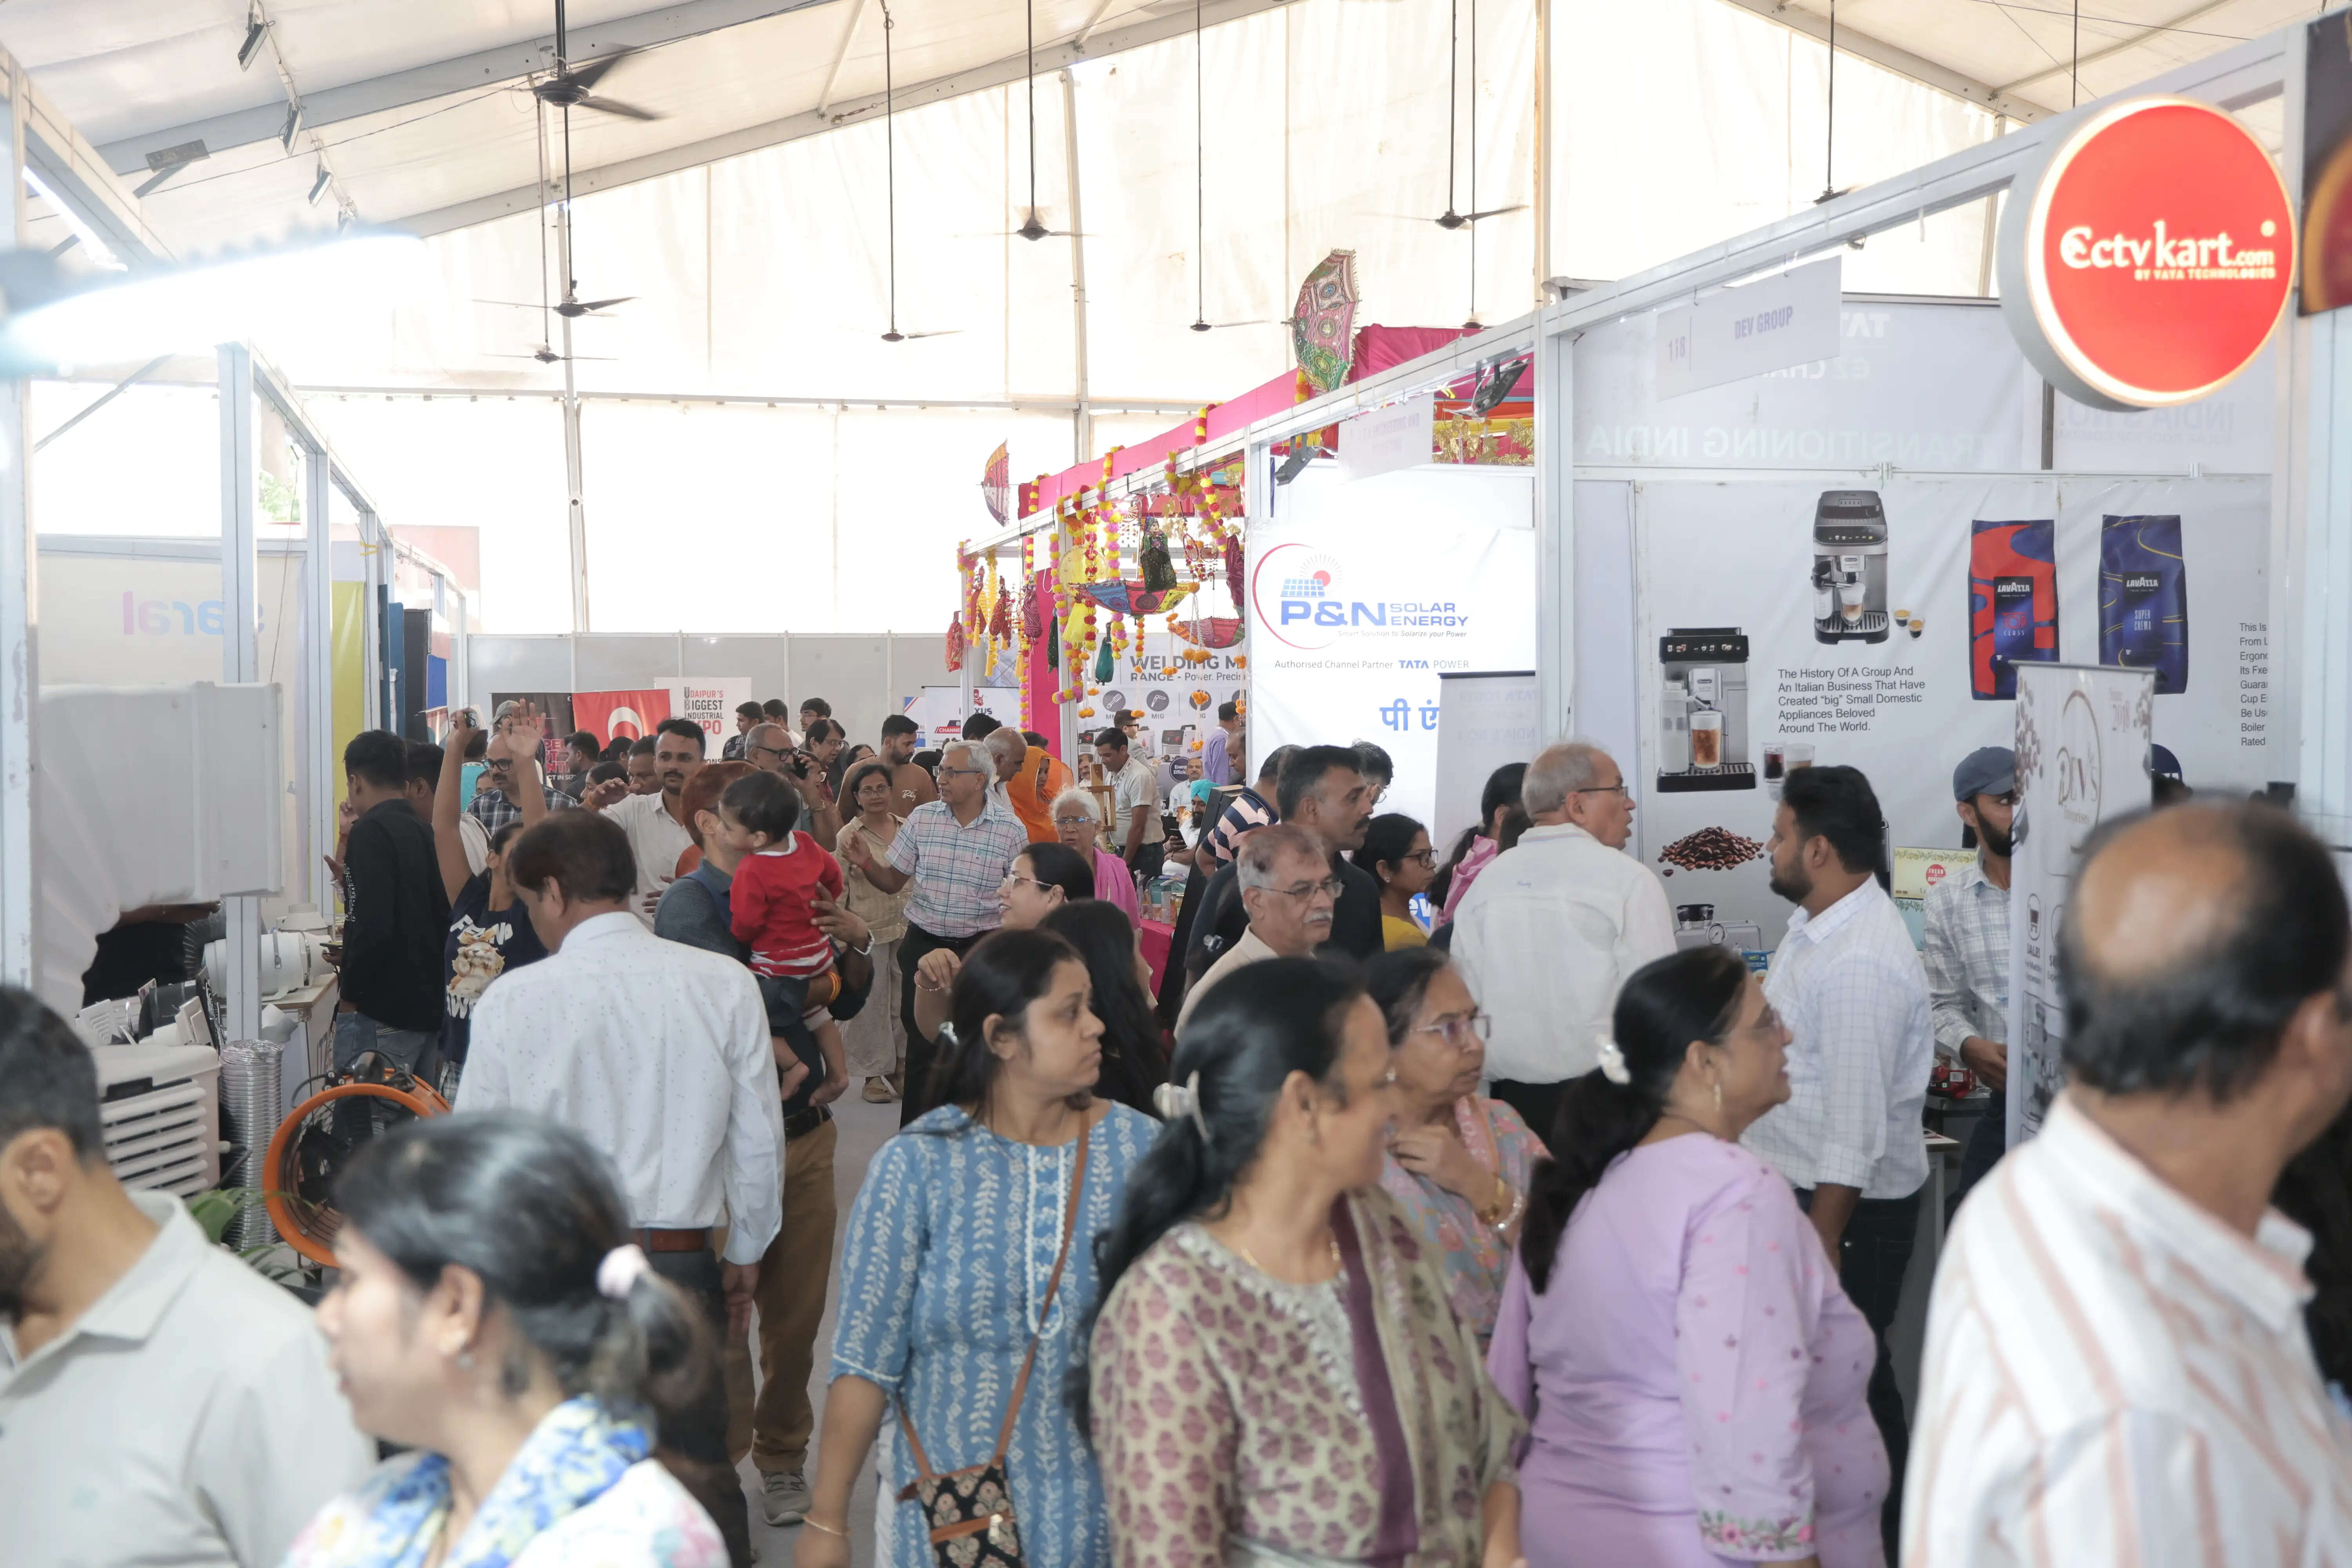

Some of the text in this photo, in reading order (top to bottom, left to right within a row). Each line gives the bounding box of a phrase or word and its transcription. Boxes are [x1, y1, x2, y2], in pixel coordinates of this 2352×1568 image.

[2134, 269, 2151, 281] BY
[2187, 268, 2275, 279] TECHNOLOGIES
[1668, 305, 1794, 361] 118 DEV GROUP
[1997, 582, 2030, 592] LAVAZZA
[2126, 577, 2158, 587] LAVAZZA
[1281, 601, 1455, 626] P&N SOLAR
[2134, 609, 2151, 619] SUPER
[1391, 616, 1469, 626] ENERGY
[2134, 621, 2151, 631] CREMA
[2239, 623, 2267, 632] This Is
[2240, 637, 2261, 646] From
[1275, 660, 1322, 668] Authorised
[1325, 660, 1359, 668] Channel
[1399, 660, 1430, 669] TATA
[1434, 660, 1469, 668] POWER
[1778, 666, 1913, 679] The History Of A Group And
[2240, 666, 2250, 675] Its
[1131, 672, 1174, 681] RANGE
[1778, 680, 1925, 692] An Italian Business That Have
[2240, 681, 2268, 689] Guara
[684, 687, 723, 698] UDAIPUR'S
[1778, 696, 1817, 706] Created
[1846, 694, 1873, 704] Small
[1876, 693, 1922, 703] Domestic
[2241, 694, 2258, 705] Cup
[1379, 698, 1410, 731] पी
[1778, 708, 1875, 721] Appliances Beloved
[2241, 709, 2252, 717] Be
[1779, 721, 1871, 733] Around The World.
[2241, 723, 2265, 732] Boiler
[2241, 737, 2266, 746] Rated
